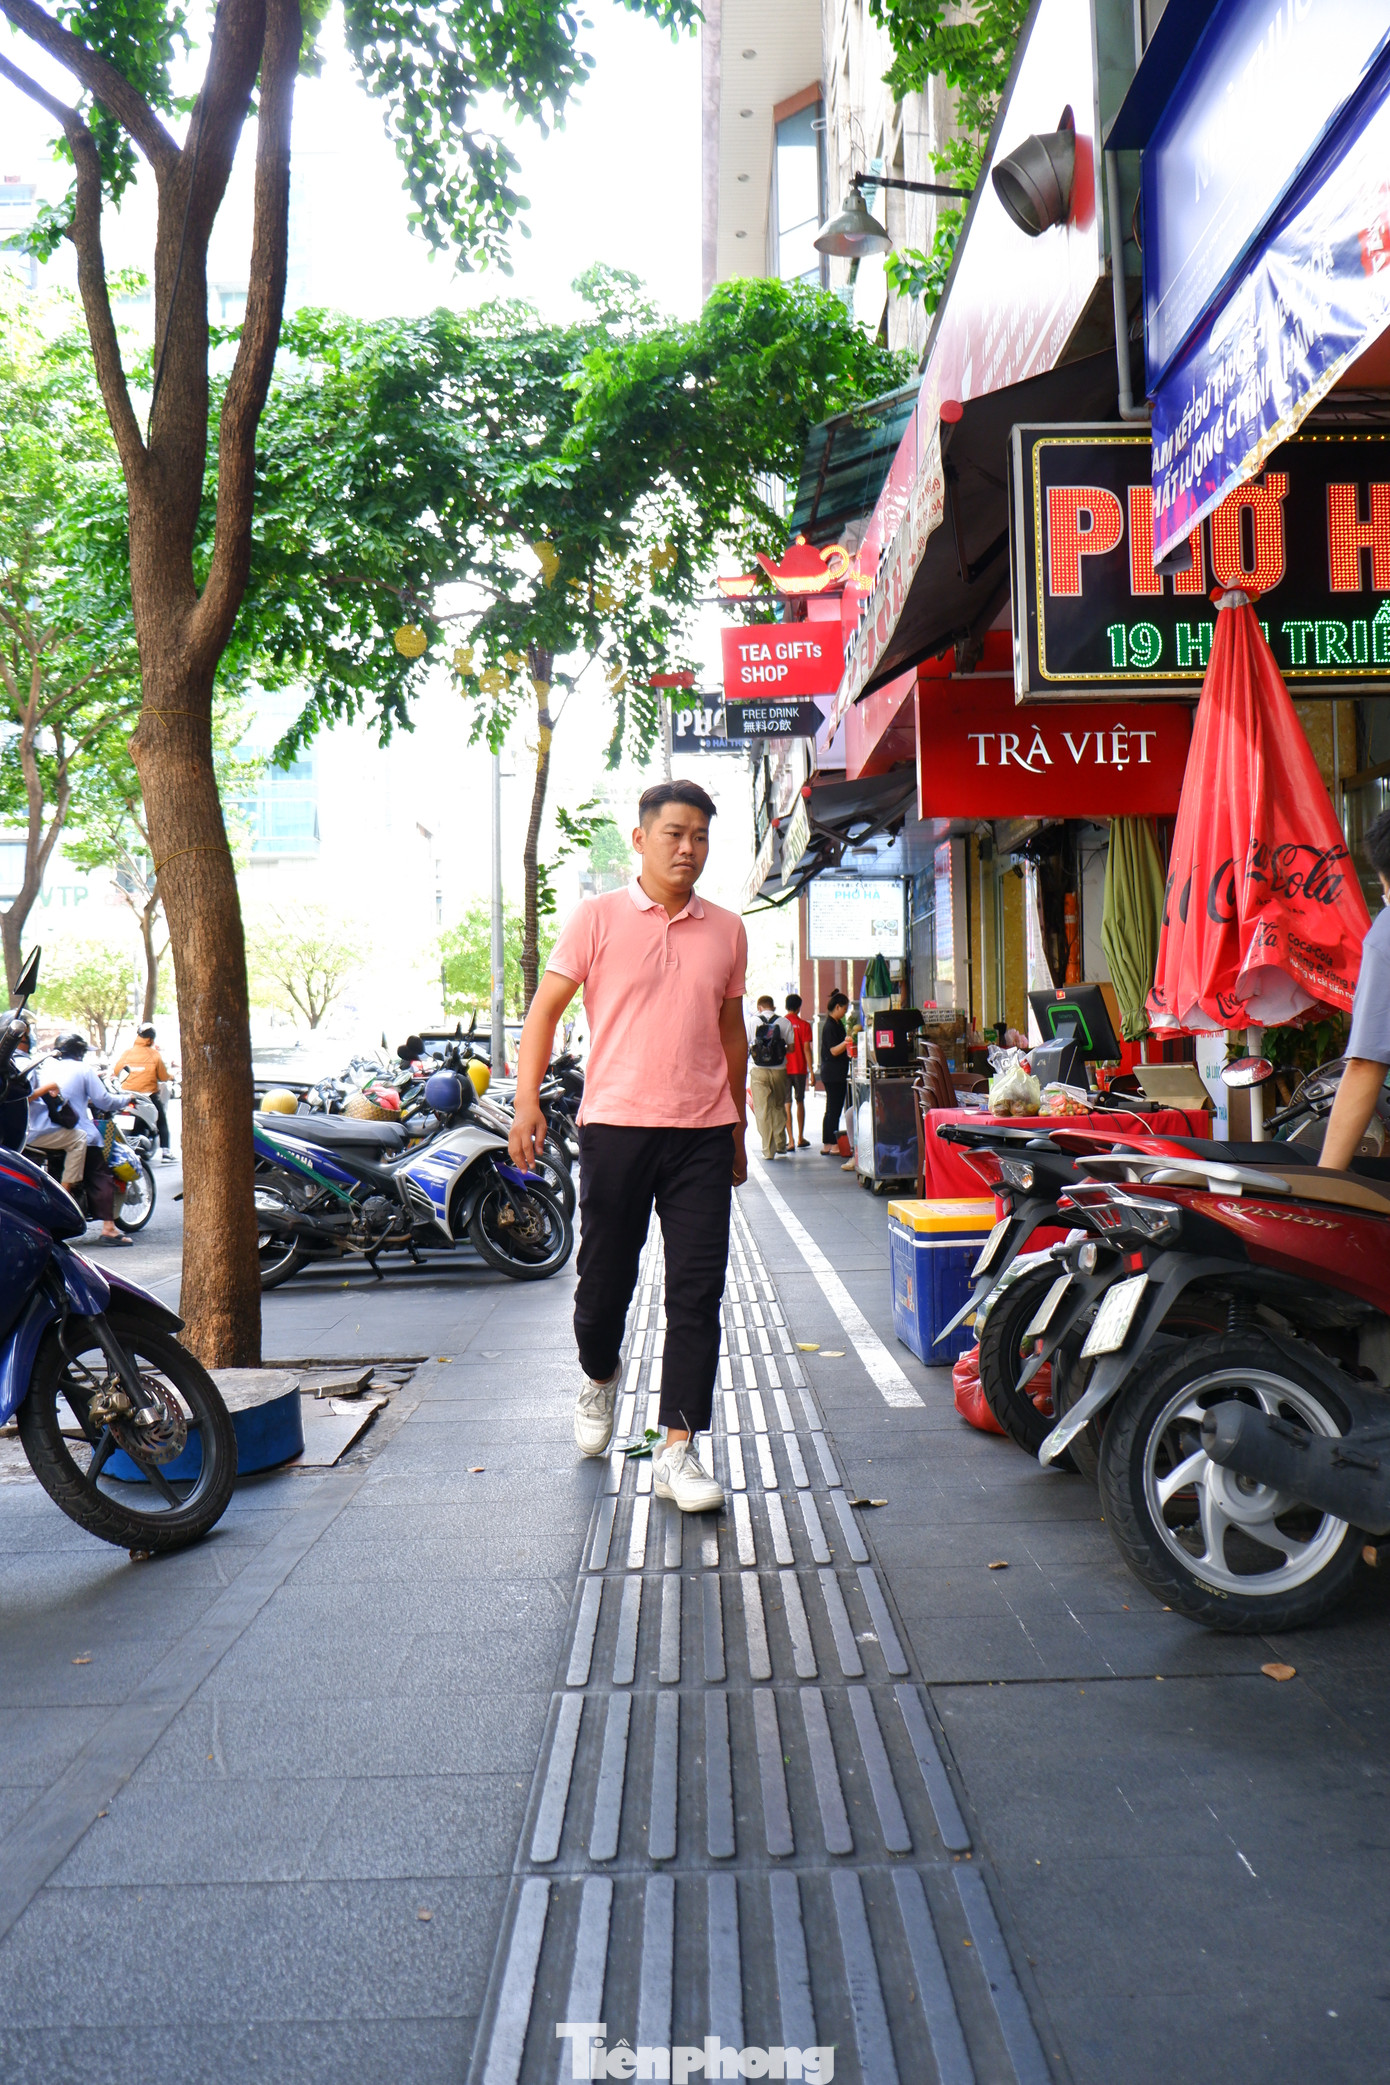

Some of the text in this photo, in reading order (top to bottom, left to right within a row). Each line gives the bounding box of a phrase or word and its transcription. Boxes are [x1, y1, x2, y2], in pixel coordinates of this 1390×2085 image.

[739, 643, 772, 662] TEA
[1106, 621, 1163, 669] 19
[741, 664, 788, 683] SHOP
[742, 707, 800, 720] FREE DRINK
[743, 720, 792, 733] 無料の飲
[968, 722, 1158, 775] TRÀ VIỆT
[863, 887, 881, 900] HÀ
[1287, 932, 1334, 967] Coca-Cola
